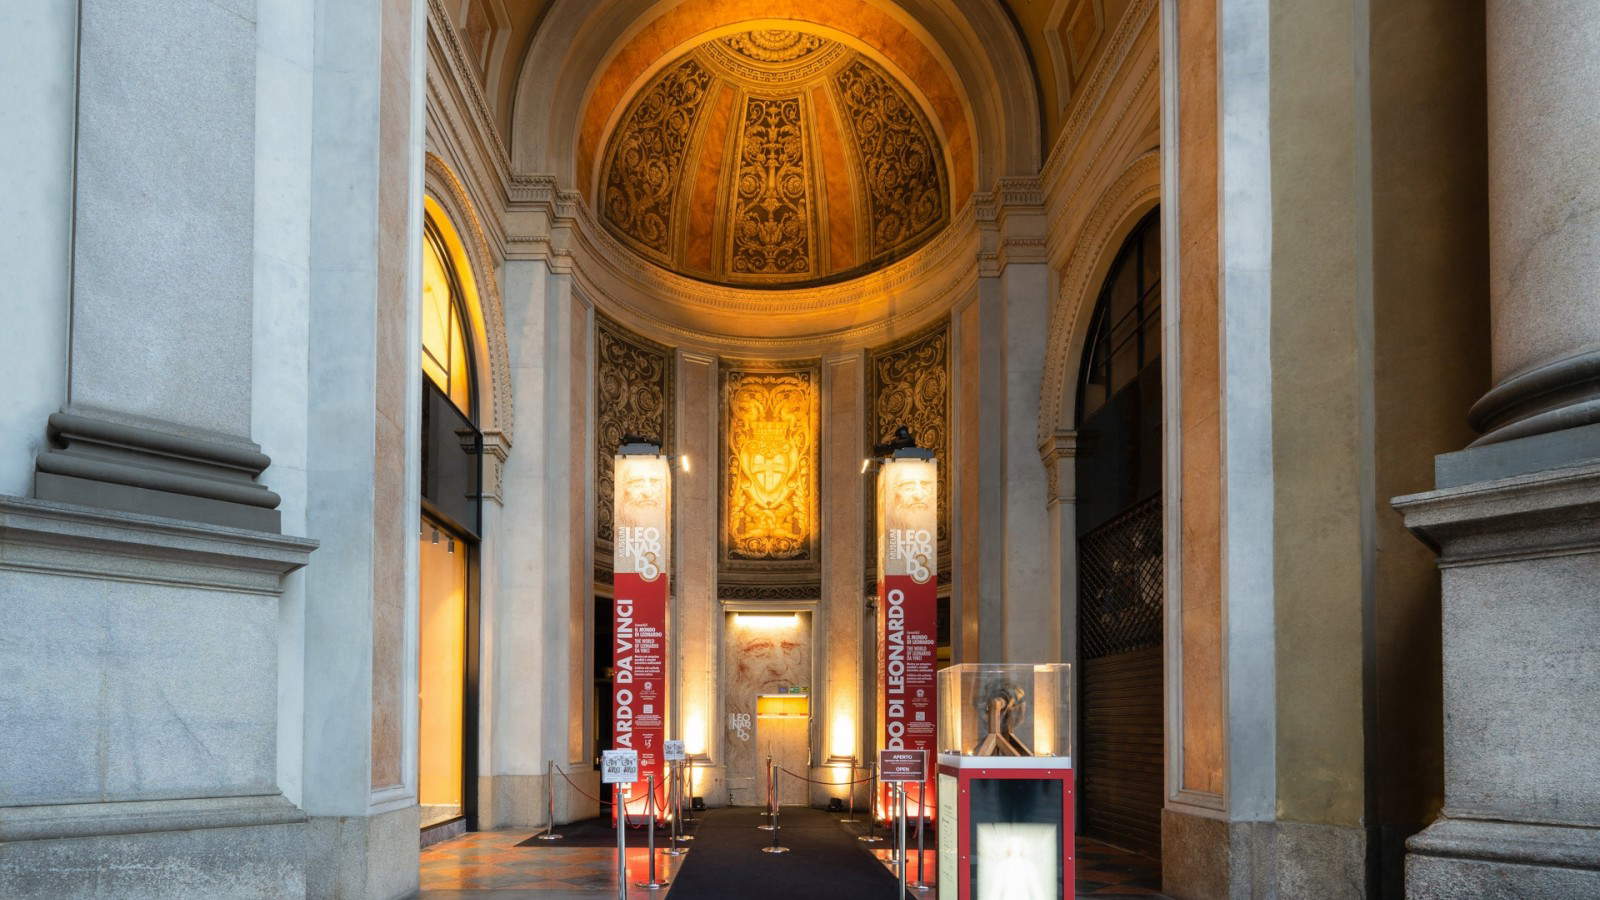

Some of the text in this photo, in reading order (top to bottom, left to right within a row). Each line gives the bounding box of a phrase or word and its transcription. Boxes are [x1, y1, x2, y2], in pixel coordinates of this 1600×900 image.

[625, 527, 660, 542] LEO
[897, 529, 931, 545] LEO
[616, 600, 633, 653] VINCI
[888, 589, 904, 693] LEONARDO
[616, 656, 633, 684] DA
[888, 700, 904, 717] DI
